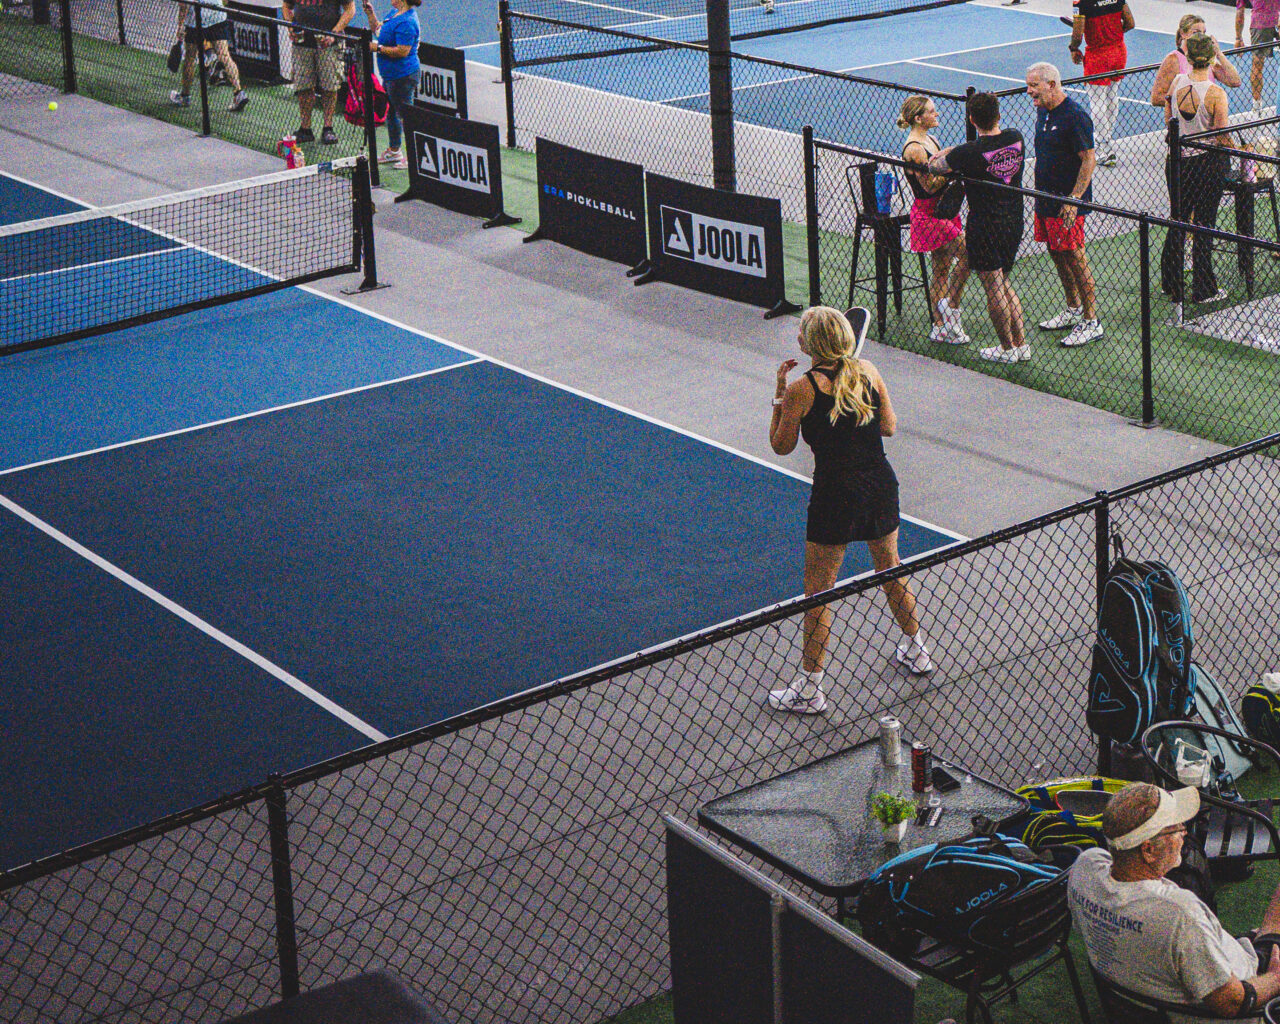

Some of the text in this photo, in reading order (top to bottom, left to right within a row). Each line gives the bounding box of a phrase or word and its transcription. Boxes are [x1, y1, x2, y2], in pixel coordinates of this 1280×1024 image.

[419, 70, 455, 103] JOOLA
[441, 146, 488, 187] JOOLA
[566, 191, 636, 221] PICKLEBALL
[697, 223, 763, 269] JOOLA
[965, 883, 1009, 913] JOOLA
[1099, 906, 1144, 933] RESILIENCE
